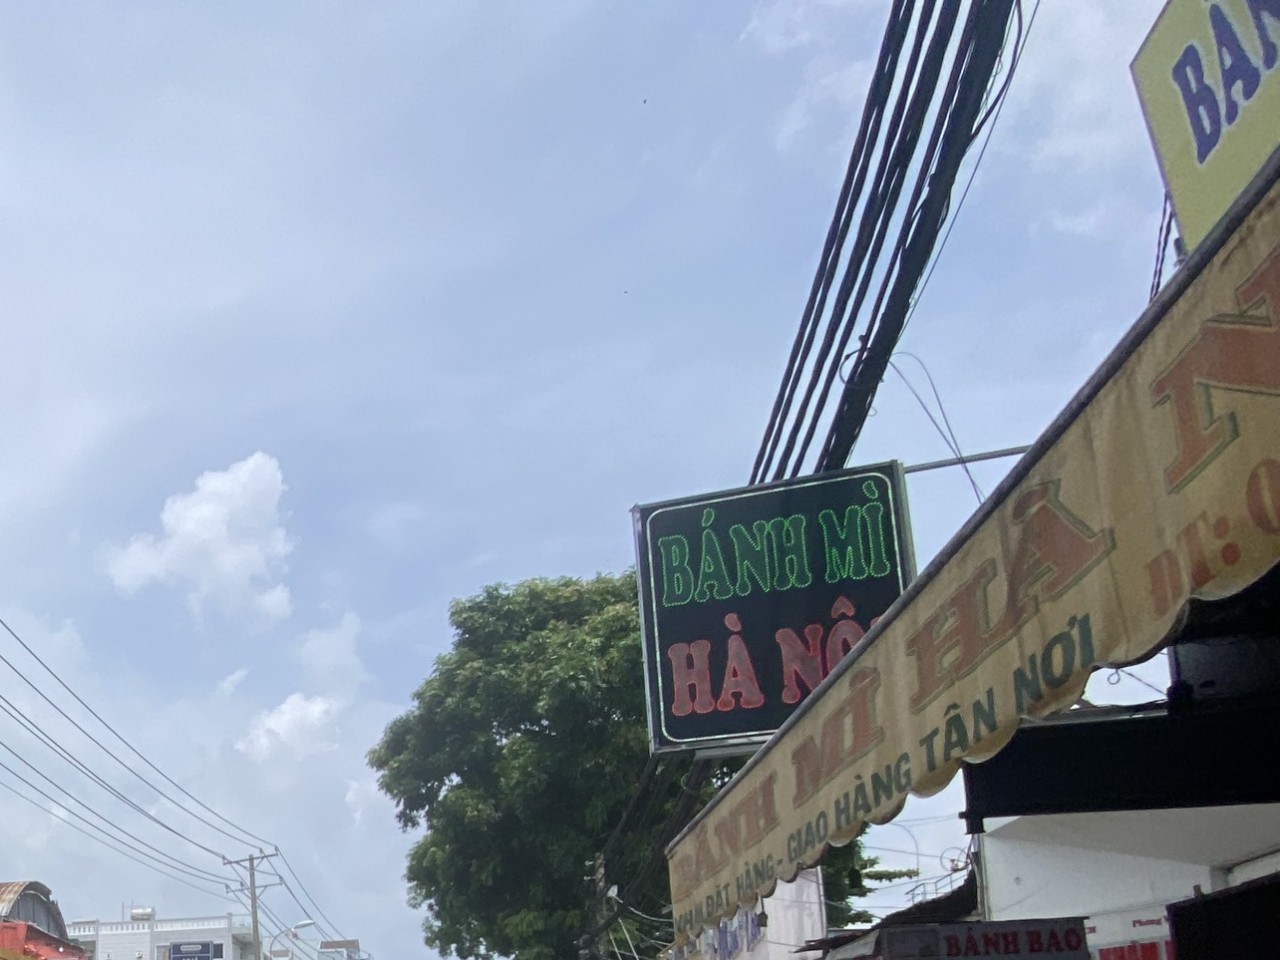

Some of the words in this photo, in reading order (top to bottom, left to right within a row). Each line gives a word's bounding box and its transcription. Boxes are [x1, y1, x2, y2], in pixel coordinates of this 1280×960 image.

[657, 508, 812, 607] BÁNH
[819, 480, 891, 584] MÌ
[668, 612, 765, 716] HÀ
[736, 856, 775, 901] HÀNG
[787, 811, 828, 865] GIAO
[834, 752, 913, 830] HÀNG
[944, 927, 1023, 957] BÁNH
[1026, 928, 1083, 954] BAO
